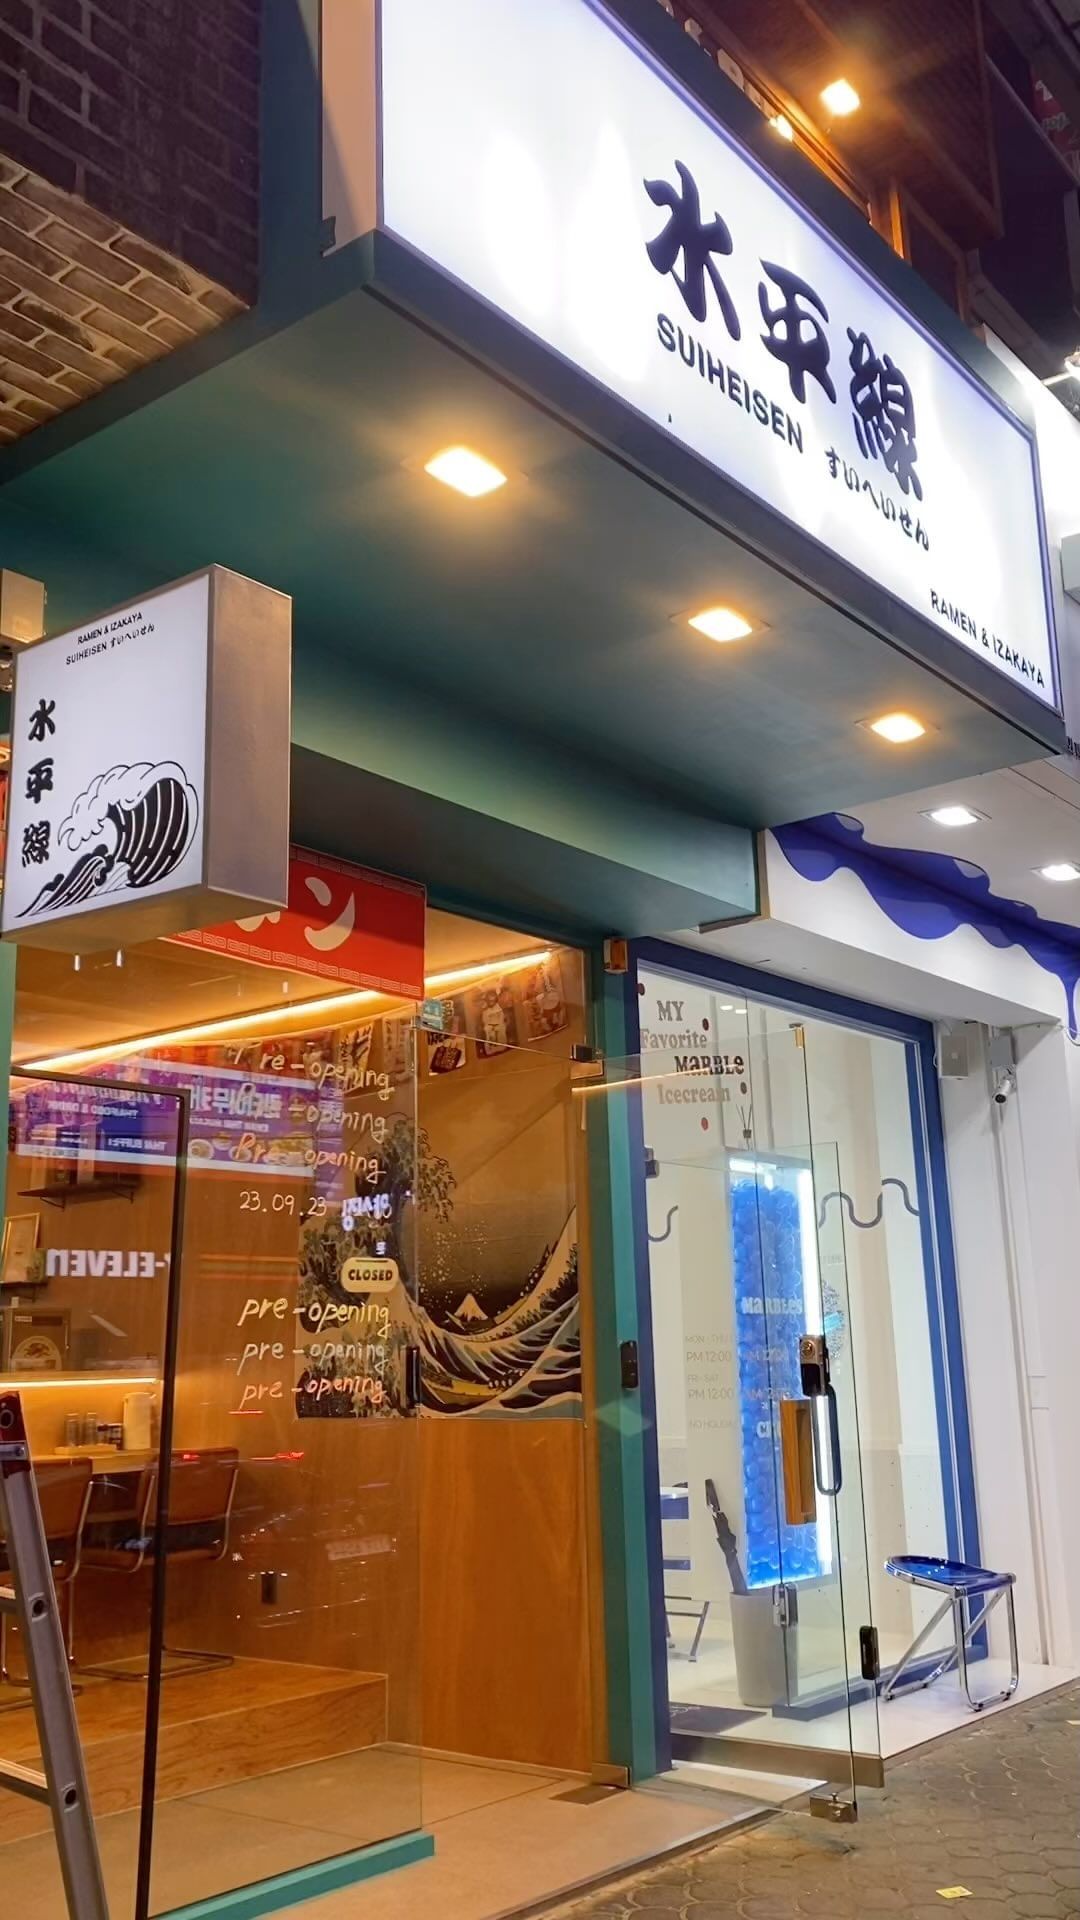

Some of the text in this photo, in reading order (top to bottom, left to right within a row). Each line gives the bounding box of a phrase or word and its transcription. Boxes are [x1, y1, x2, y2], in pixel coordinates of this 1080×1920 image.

[657, 313, 803, 454] SUIHEISEN
[825, 446, 929, 551] すいへいせん
[77, 627, 102, 645] RAMEN
[110, 611, 143, 631] IZAKAYA
[930, 588, 1044, 688] RAMEN & IZAKAYA
[66, 641, 107, 665] SUIHEISEN
[657, 1000, 685, 1021] MY
[640, 1028, 708, 1048] Favorite
[657, 1084, 731, 1104] Icecream
[239, 1190, 328, 1217] 23.09.23
[348, 1268, 393, 1281] CLOSED
